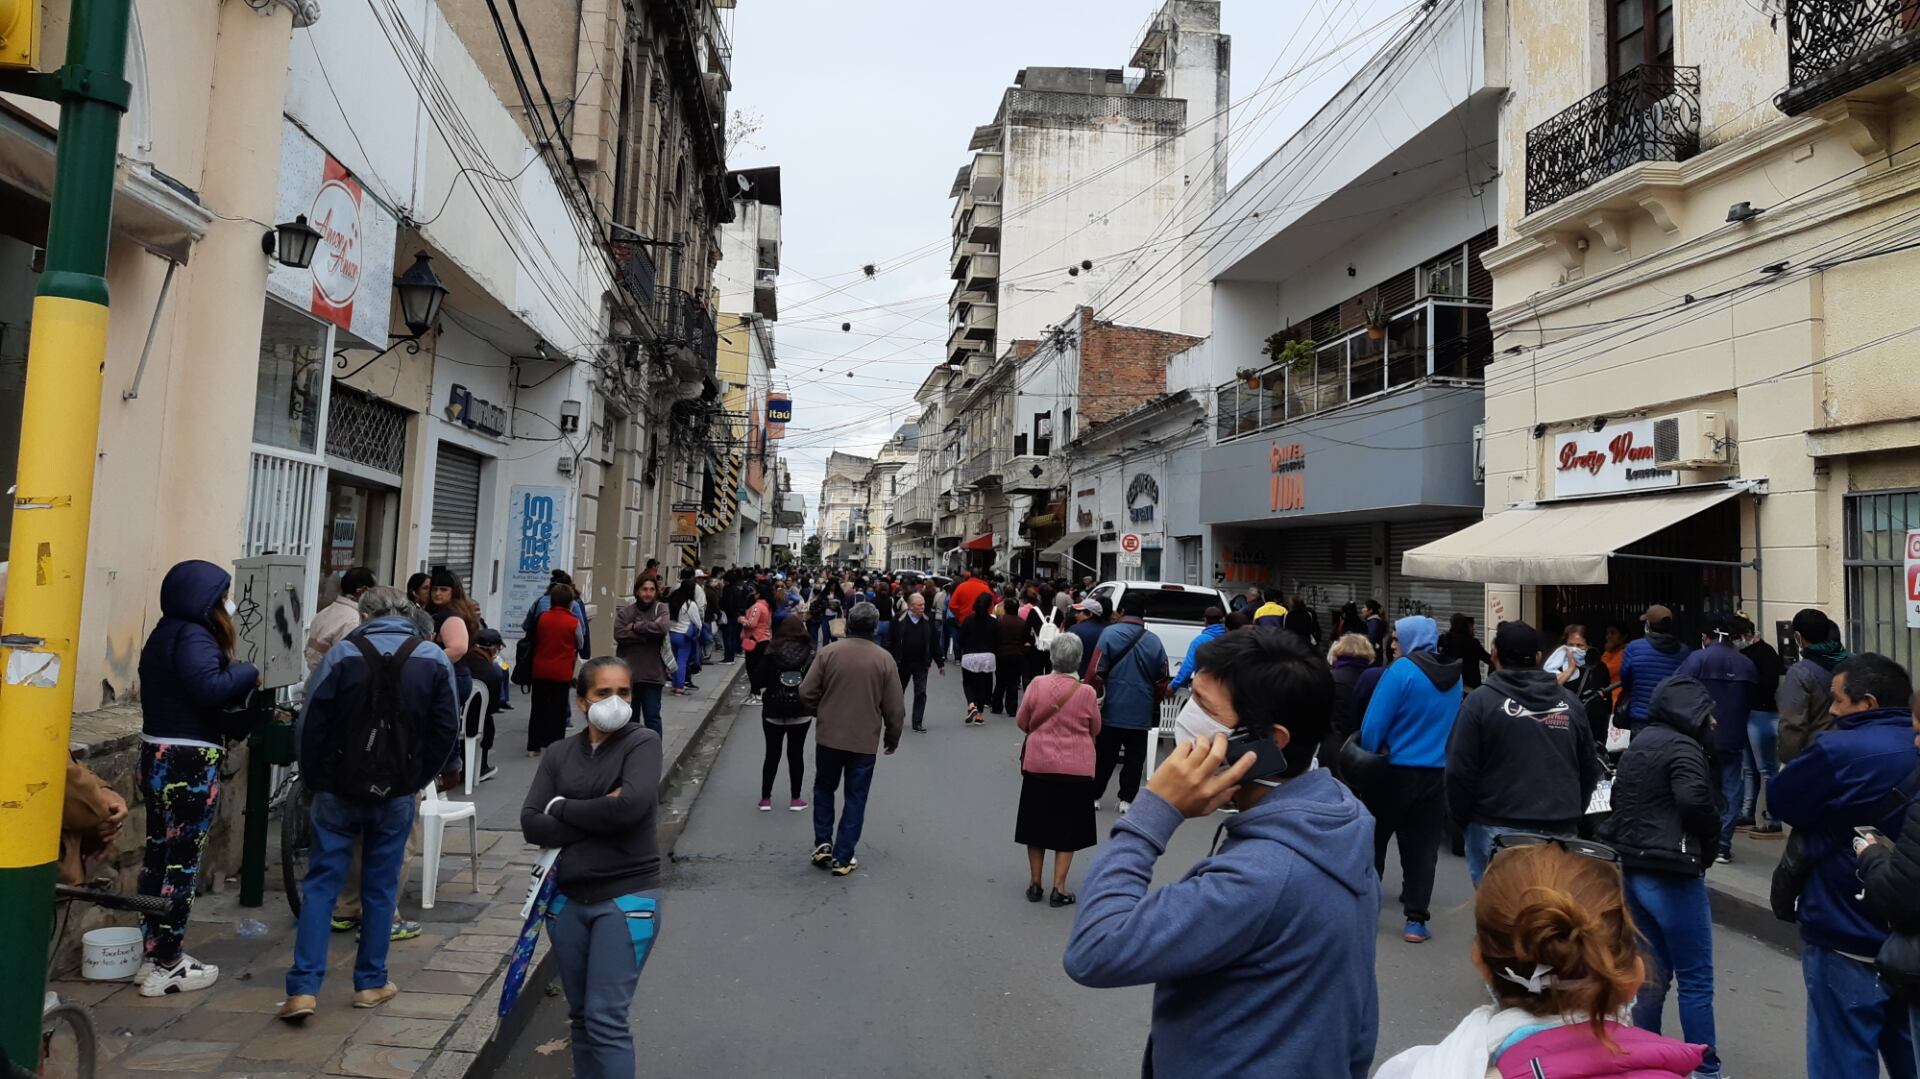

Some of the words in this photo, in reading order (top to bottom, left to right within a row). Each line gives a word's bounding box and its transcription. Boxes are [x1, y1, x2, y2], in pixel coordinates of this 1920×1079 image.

[769, 409, 790, 420] Itaú
[1557, 441, 1606, 476] Pretty
[1271, 475, 1305, 512] VIDA
